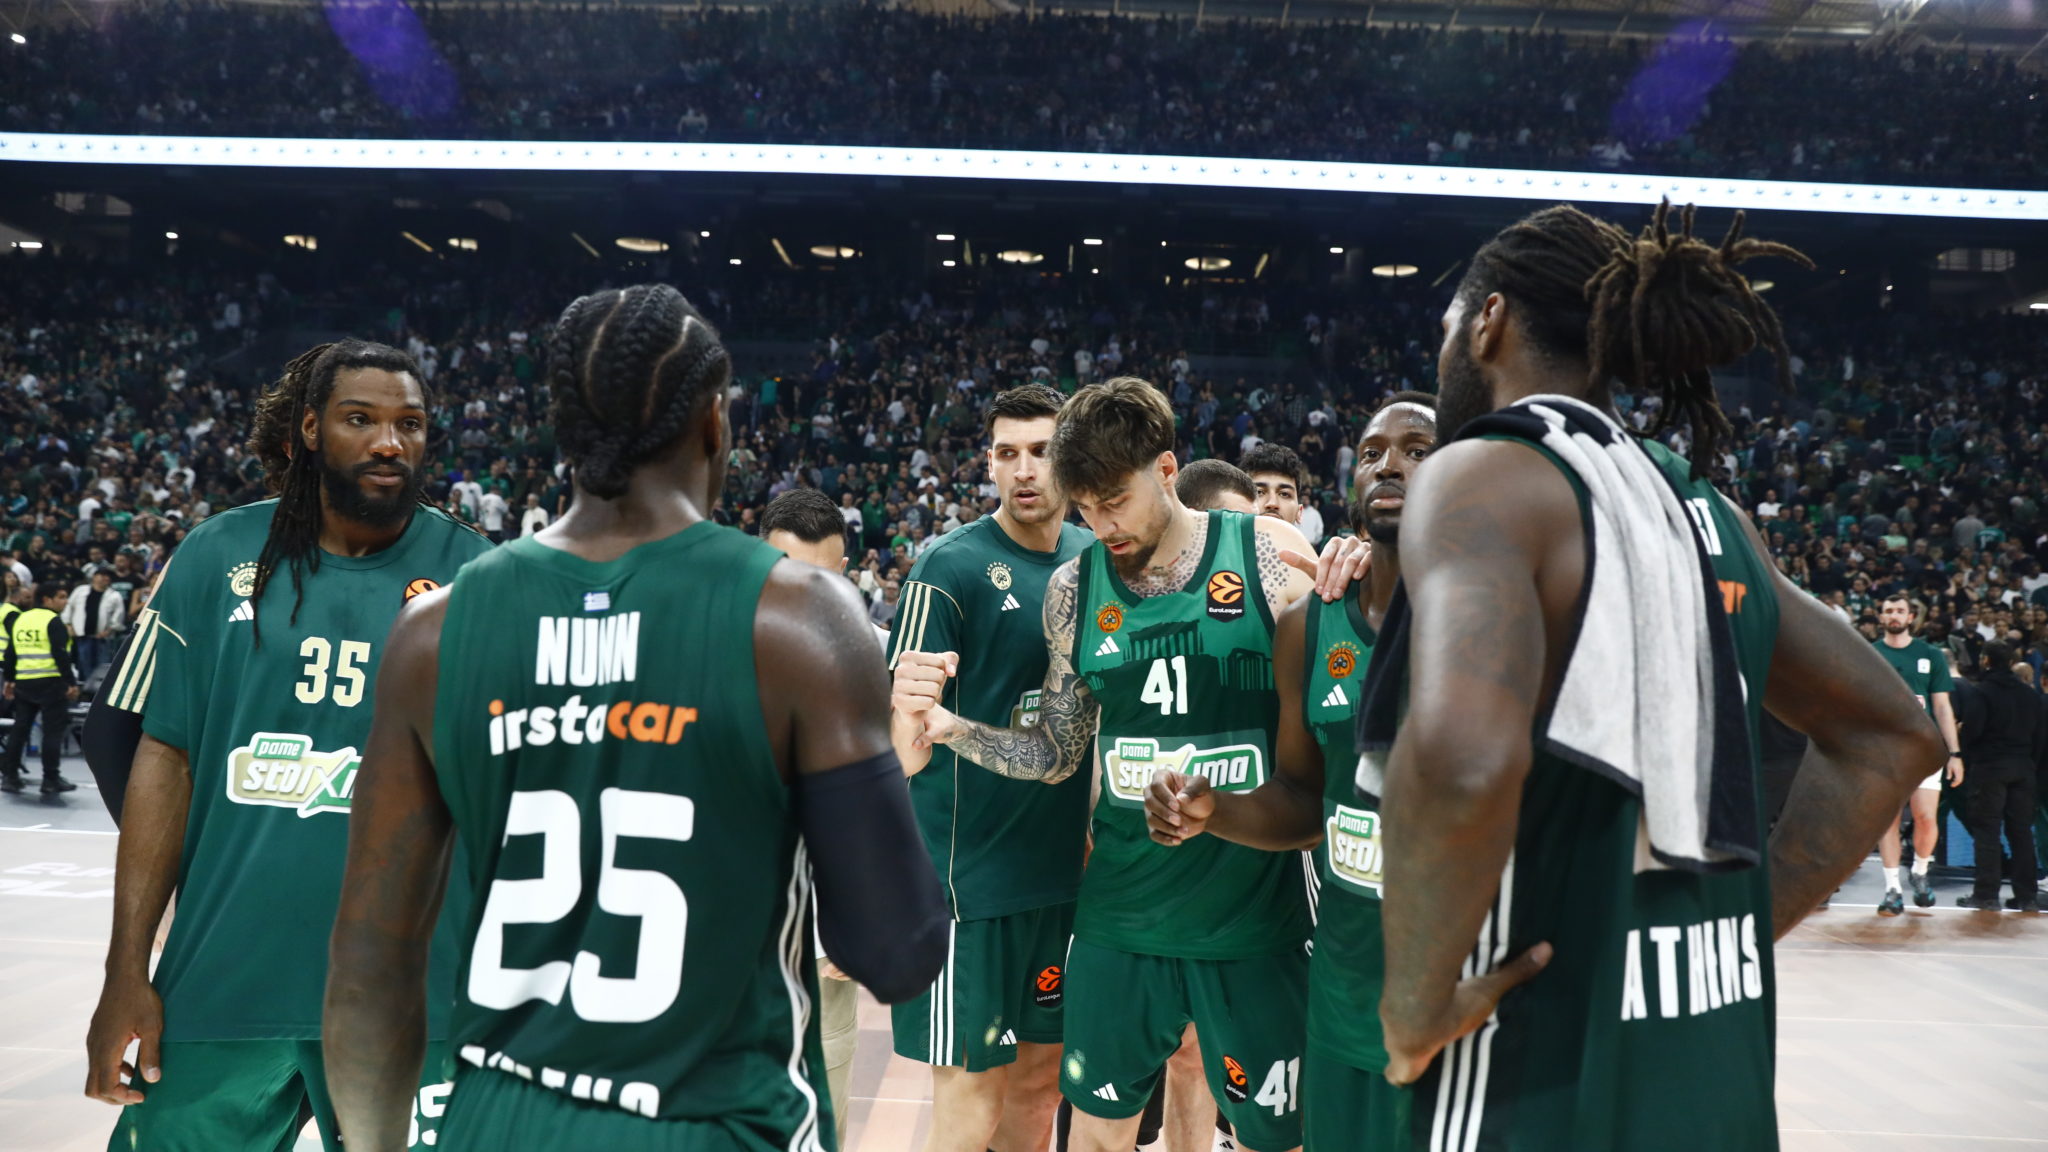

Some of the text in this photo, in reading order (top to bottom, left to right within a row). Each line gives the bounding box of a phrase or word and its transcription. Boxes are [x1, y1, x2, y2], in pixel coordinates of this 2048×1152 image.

[1208, 606, 1243, 615] EuroLeague
[16, 629, 41, 642] CSI
[295, 636, 371, 708] 35
[1140, 655, 1188, 716] 41
[257, 741, 301, 757] pame
[1122, 744, 1150, 758] pame
[1340, 814, 1370, 834] pame
[468, 787, 695, 1023] 25
[1254, 1056, 1300, 1117] 41
